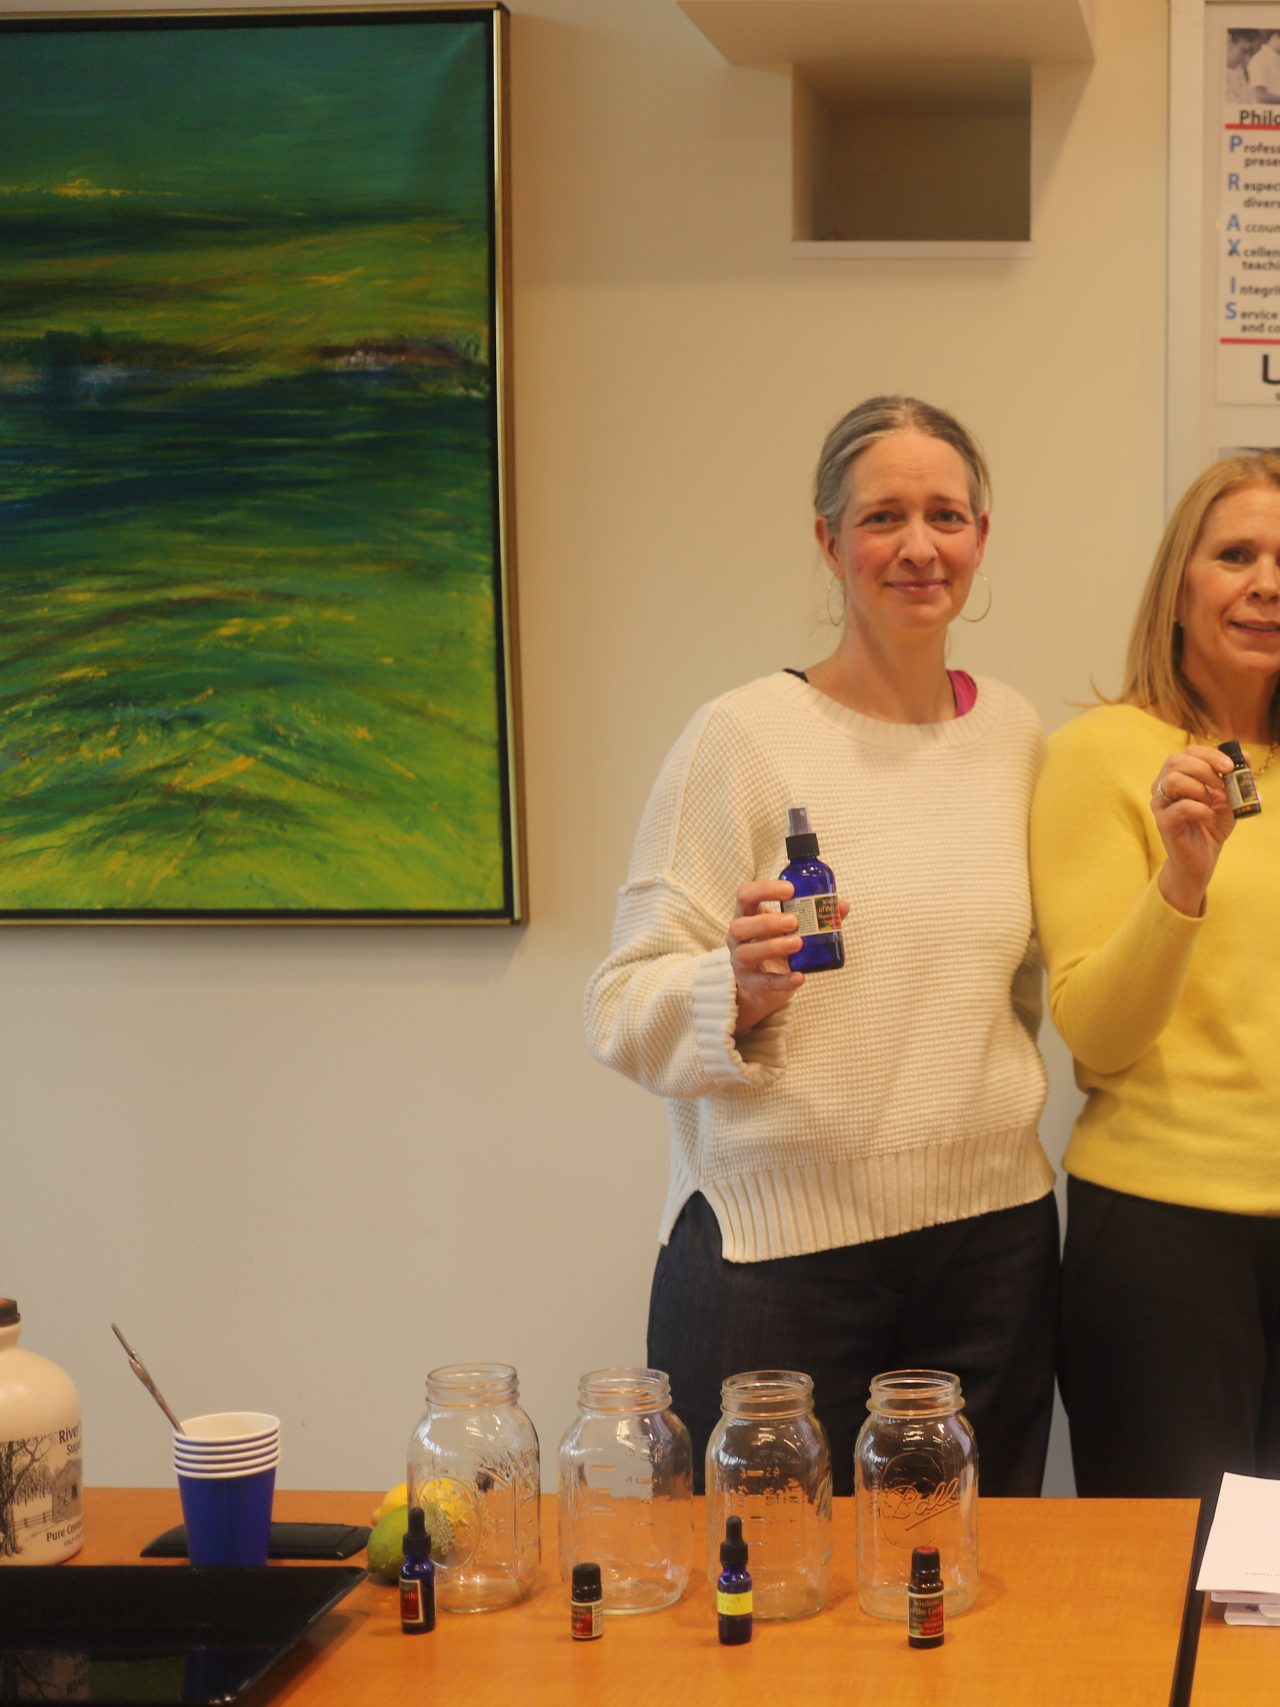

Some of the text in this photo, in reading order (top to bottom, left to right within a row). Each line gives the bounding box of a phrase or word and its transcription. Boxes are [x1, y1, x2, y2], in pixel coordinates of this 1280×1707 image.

[1240, 323, 1265, 334] and
[891, 1477, 960, 1521] Ball
[46, 1528, 66, 1543] Pure
